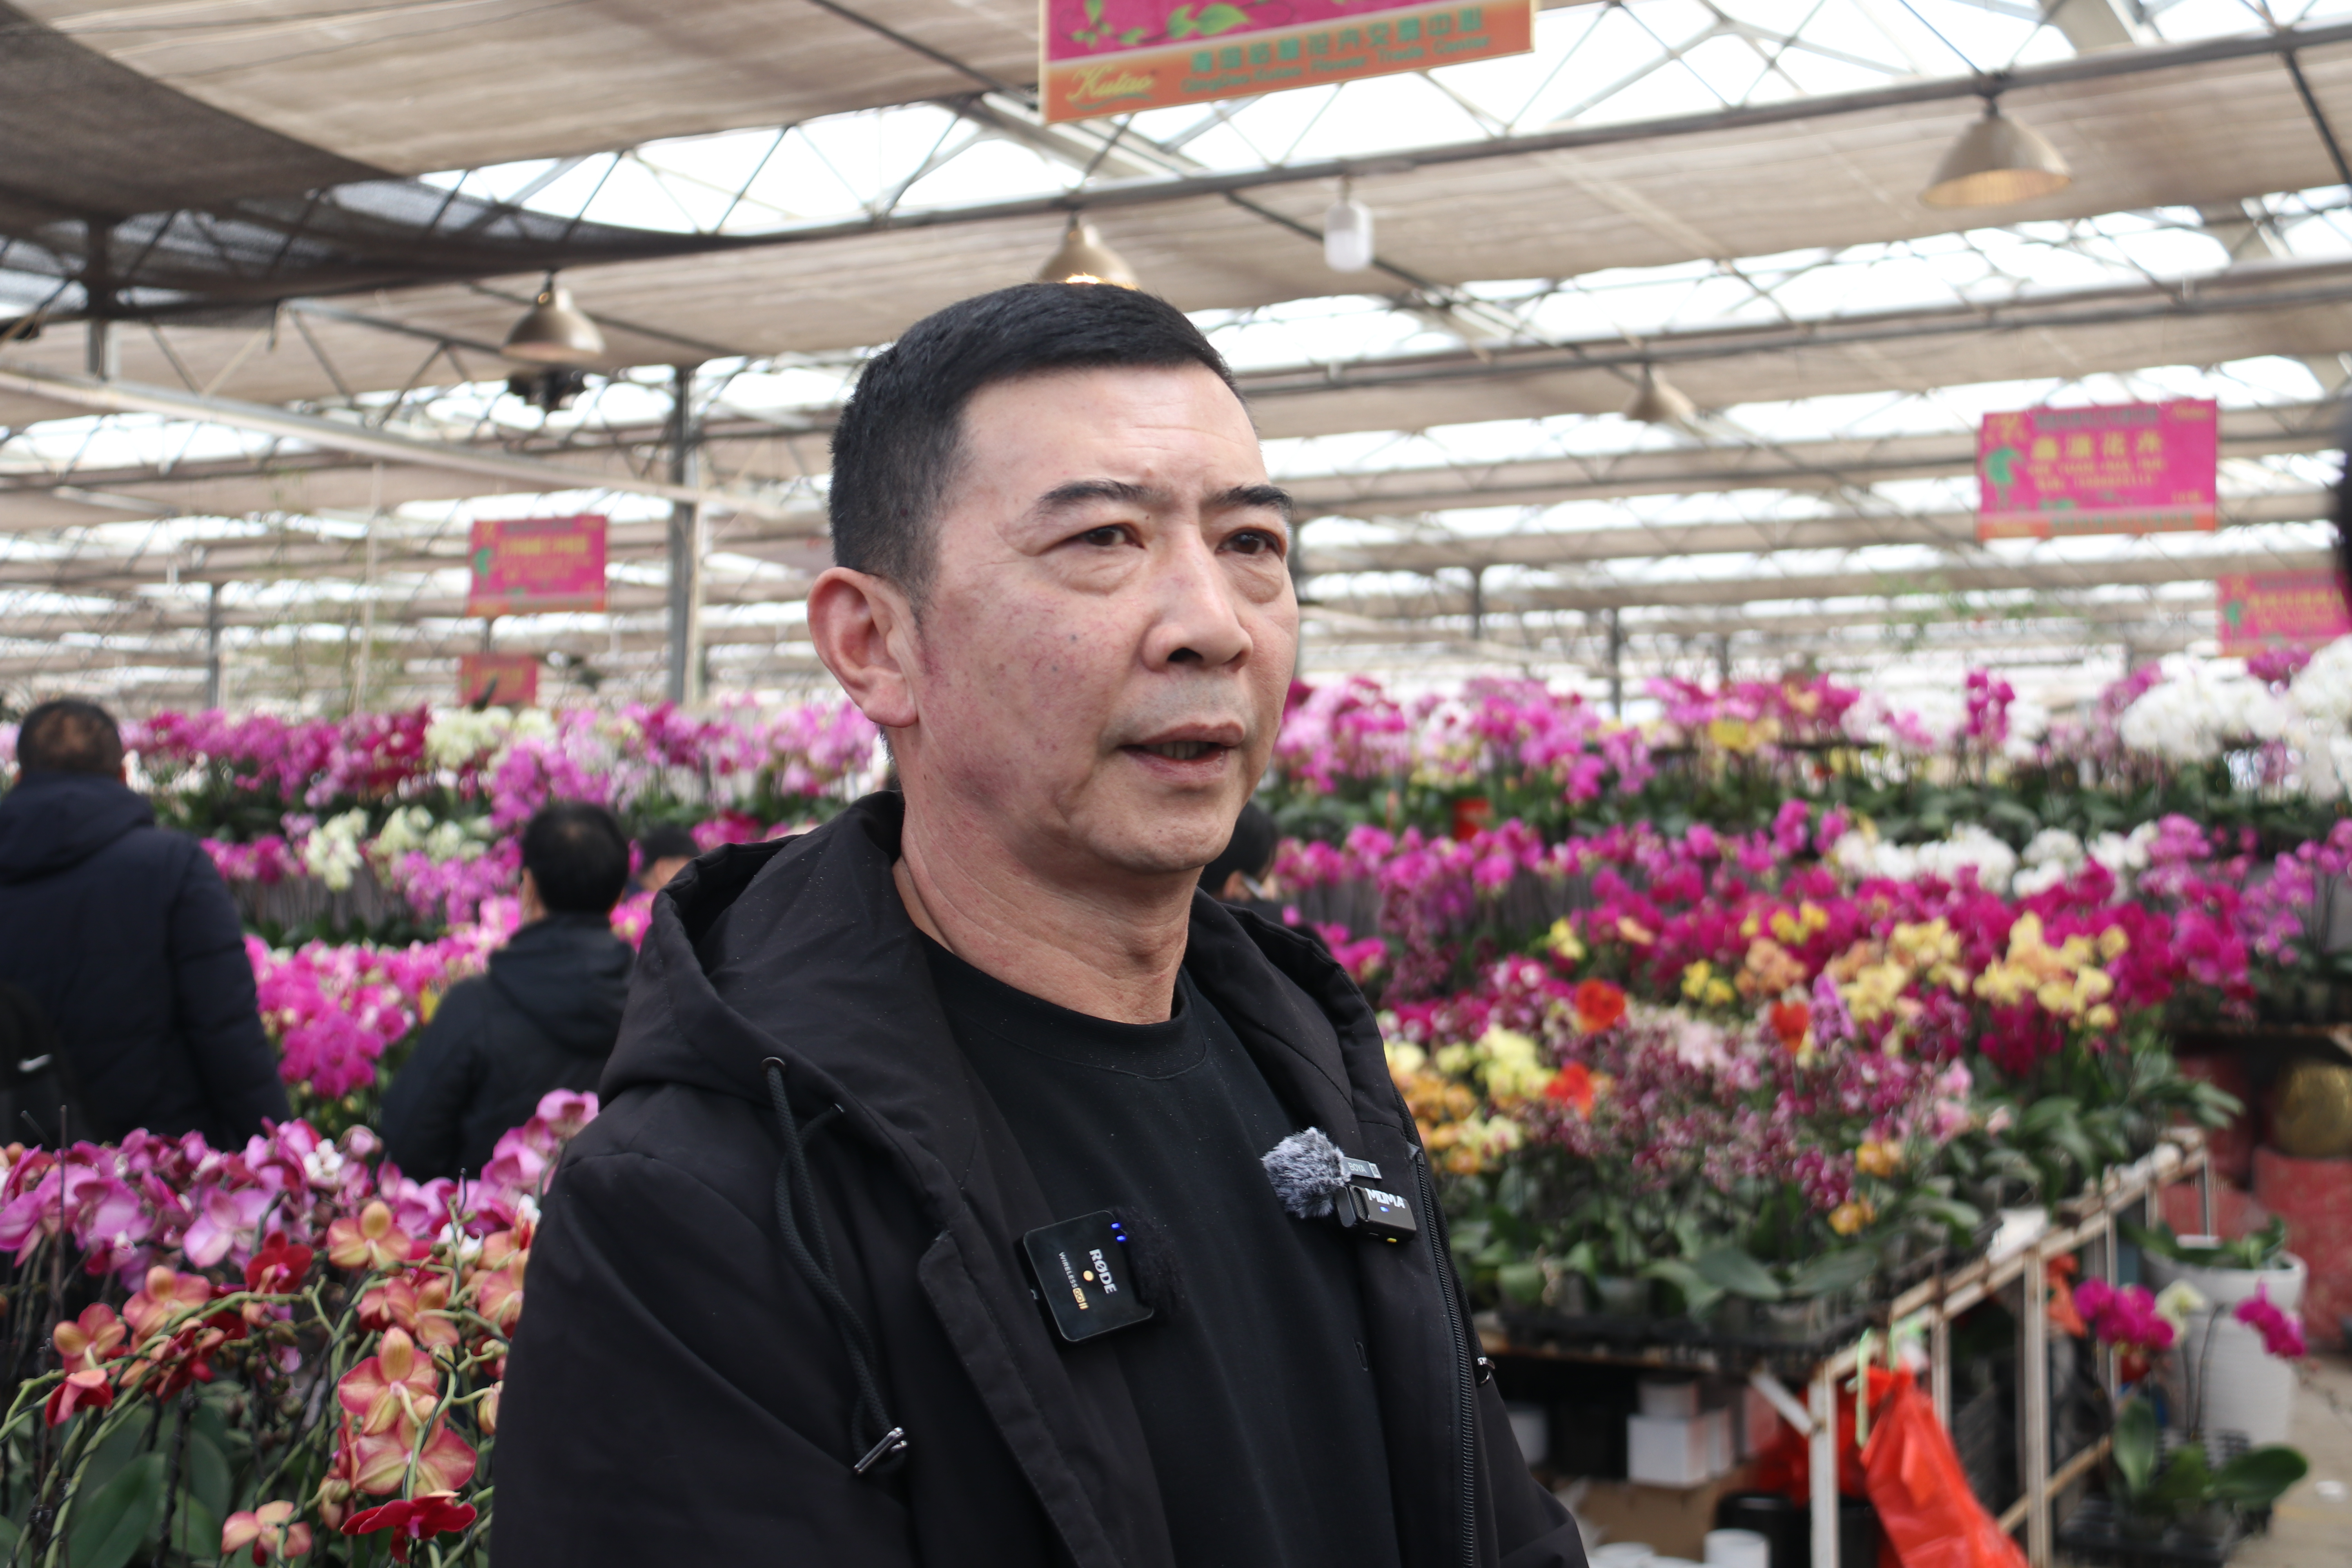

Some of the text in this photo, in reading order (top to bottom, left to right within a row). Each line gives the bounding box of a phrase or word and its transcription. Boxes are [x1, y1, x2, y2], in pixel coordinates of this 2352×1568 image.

[1347, 1162, 1367, 1173] BOYA
[1059, 1252, 1079, 1288] WIRELESS
[1089, 1249, 1117, 1294] RØDE
